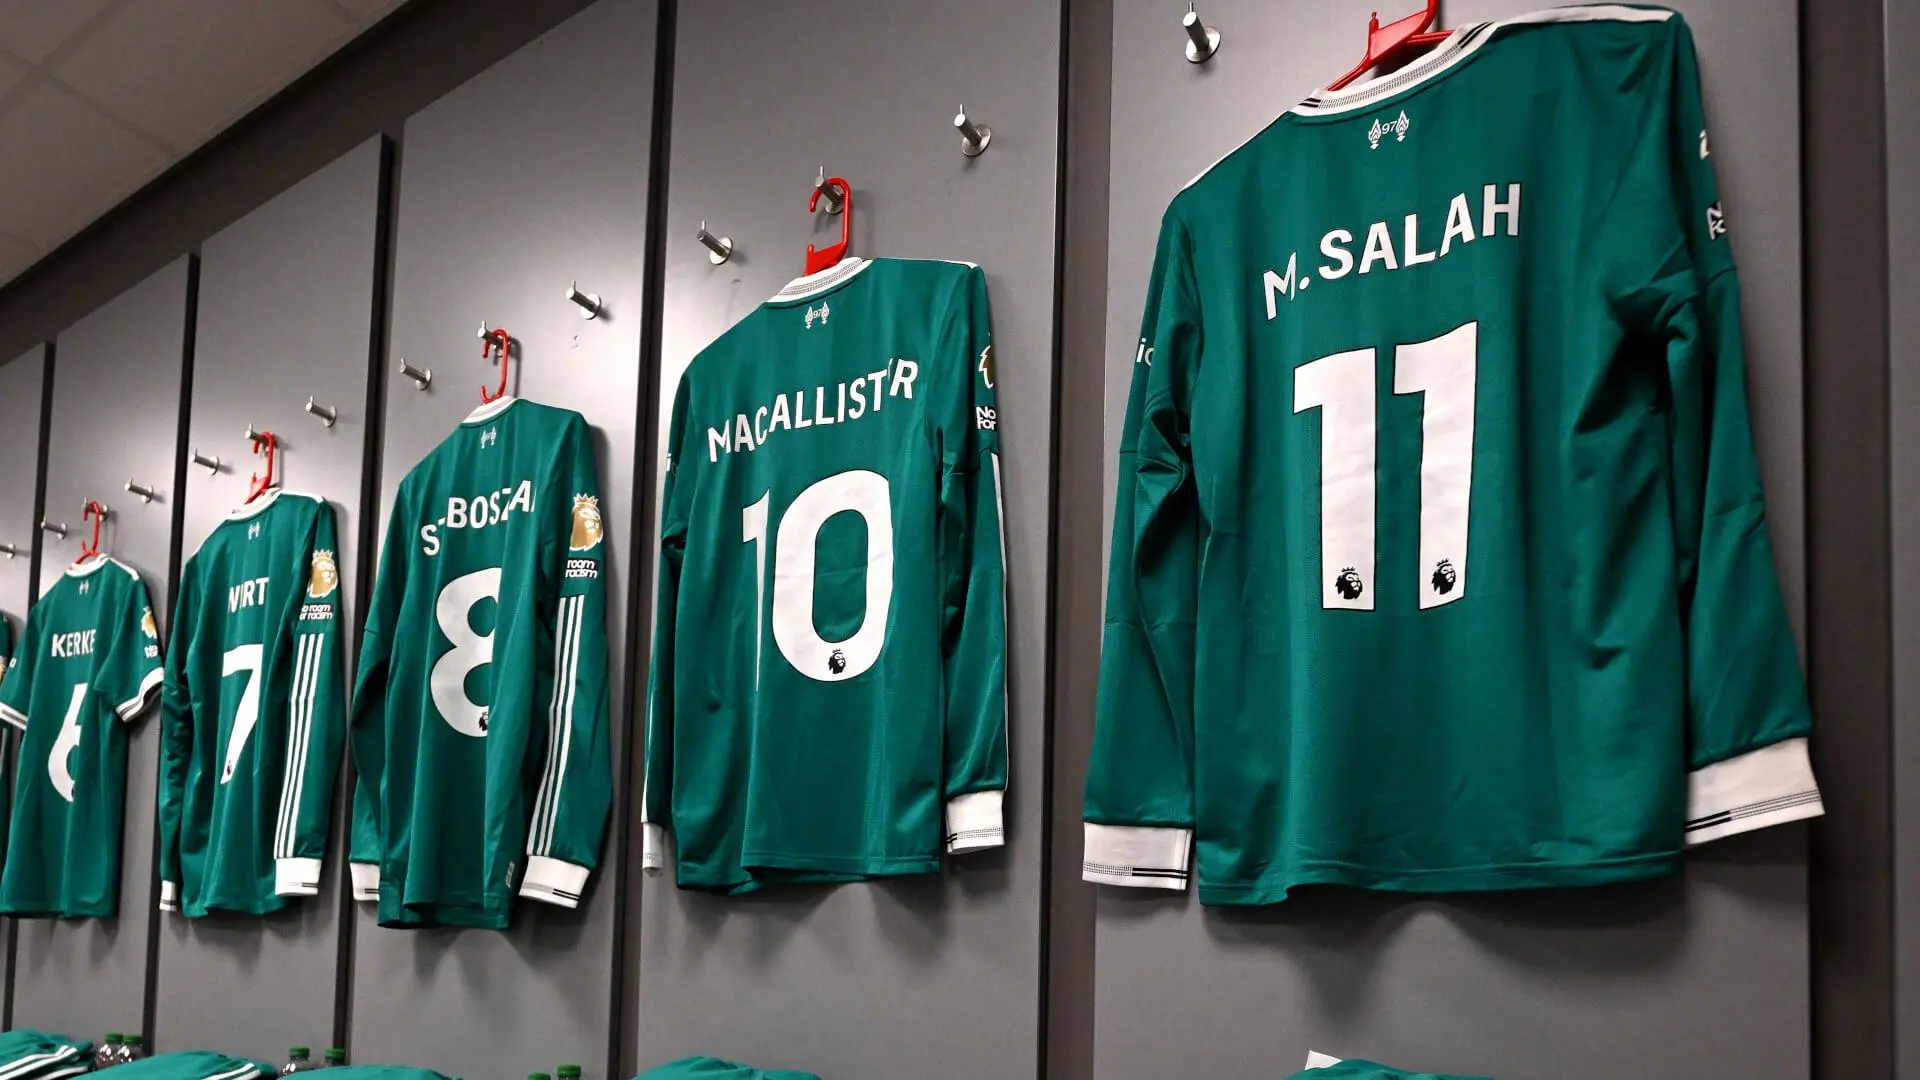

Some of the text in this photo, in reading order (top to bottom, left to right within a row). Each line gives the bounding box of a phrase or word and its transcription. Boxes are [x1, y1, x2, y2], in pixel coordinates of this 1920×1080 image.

[1381, 120, 1398, 135] 97
[975, 405, 997, 420] No
[977, 417, 997, 431] For
[1293, 320, 1478, 611] 11
[566, 559, 596, 569] room
[564, 569, 598, 579] racism
[742, 468, 893, 693] 10
[309, 604, 331, 612] room
[430, 567, 503, 738] 8
[220, 643, 264, 785] 7
